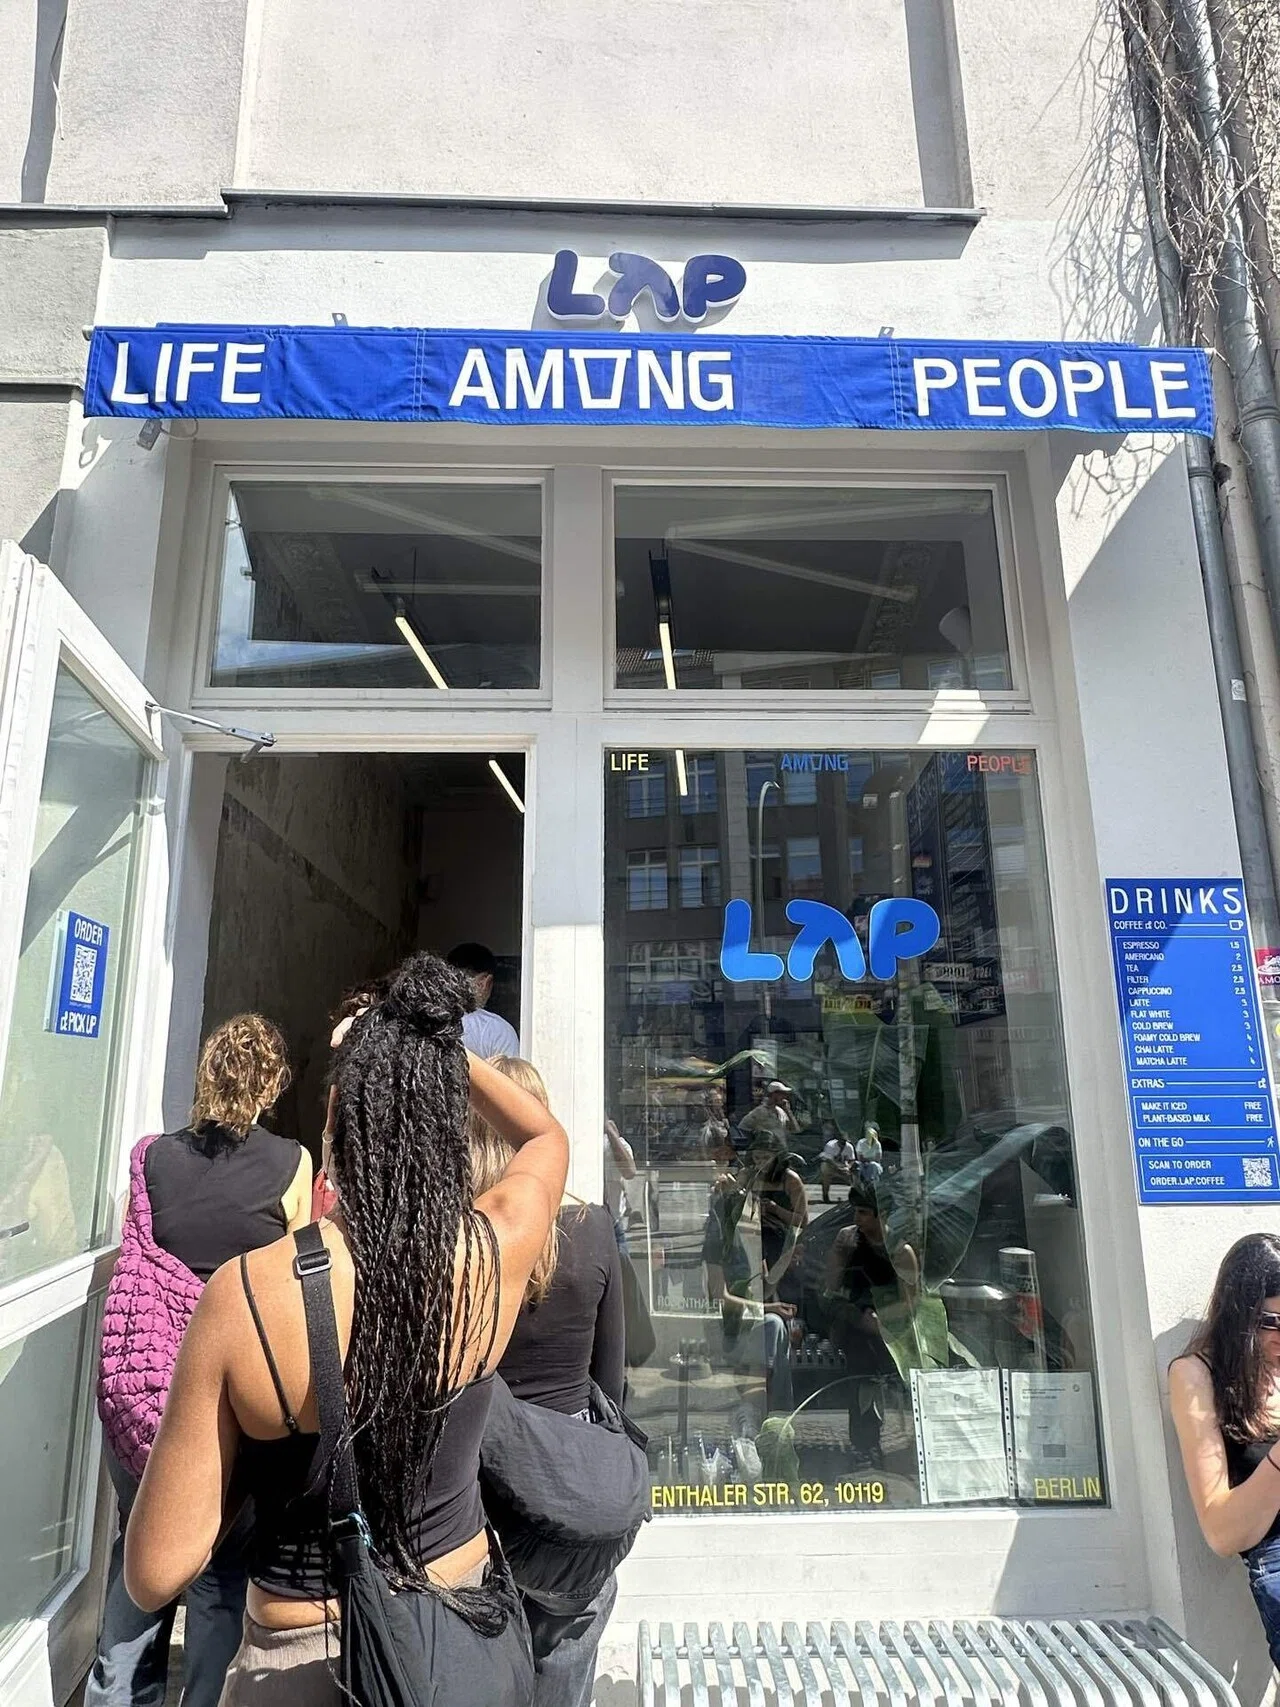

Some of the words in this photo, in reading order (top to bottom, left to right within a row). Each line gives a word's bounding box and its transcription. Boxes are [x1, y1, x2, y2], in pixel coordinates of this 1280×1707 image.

[110, 341, 266, 405] LIFE
[912, 358, 1197, 420] PEOPLE
[611, 754, 649, 771] LIFE
[966, 754, 1033, 773] PEOPLE
[1110, 887, 1242, 915] DRINKS
[1113, 920, 1144, 930] COFFEE
[1153, 920, 1168, 930] CO.
[74, 918, 103, 946] ORDER
[1123, 941, 1160, 950] ESPRESSO
[1124, 952, 1165, 961] AMERICANO
[1236, 952, 1242, 961] 2
[1126, 964, 1140, 972] TEA
[1127, 975, 1149, 984] FILTER
[1128, 987, 1173, 995] CAPPUCCINO
[1129, 999, 1151, 1007] LATTE
[1130, 1010, 1147, 1019] FLAT
[1148, 1010, 1171, 1019] WHITE
[69, 1012, 85, 1034] PICK
[86, 1015, 97, 1036] UP
[1132, 1022, 1152, 1030] COLD
[1152, 1022, 1174, 1030] BREW
[1244, 1021, 1251, 1030] 3
[1133, 1033, 1157, 1042] FOAMY
[1158, 1033, 1178, 1042] COLD
[1179, 1033, 1201, 1042] BREW
[1135, 1045, 1152, 1053] CHAI
[1153, 1045, 1174, 1053] LATTE
[1136, 1057, 1166, 1065] MATCHA
[1166, 1057, 1188, 1065] LATTE
[1132, 1079, 1165, 1089] EXTRAS
[1141, 1102, 1162, 1110] MAKE
[1162, 1102, 1170, 1110] IT
[1170, 1102, 1188, 1110] ICED
[1244, 1101, 1262, 1110] FREE
[1143, 1113, 1193, 1123] PLANT-BASED
[1193, 1113, 1212, 1123] MILK
[1245, 1113, 1264, 1122] FREE
[1138, 1137, 1152, 1148] ON
[1153, 1137, 1170, 1147] THE
[1171, 1137, 1184, 1147] GO
[1149, 1160, 1171, 1169] SCAN
[1171, 1160, 1183, 1169] TO
[1184, 1160, 1212, 1169] ORDER
[1150, 1176, 1226, 1186] ORDER.LAP.COFFEE
[753, 1483, 795, 1506] STR.
[800, 1483, 830, 1506] 62,
[834, 1481, 884, 1504] 10119
[1034, 1476, 1102, 1500] BERLIN
